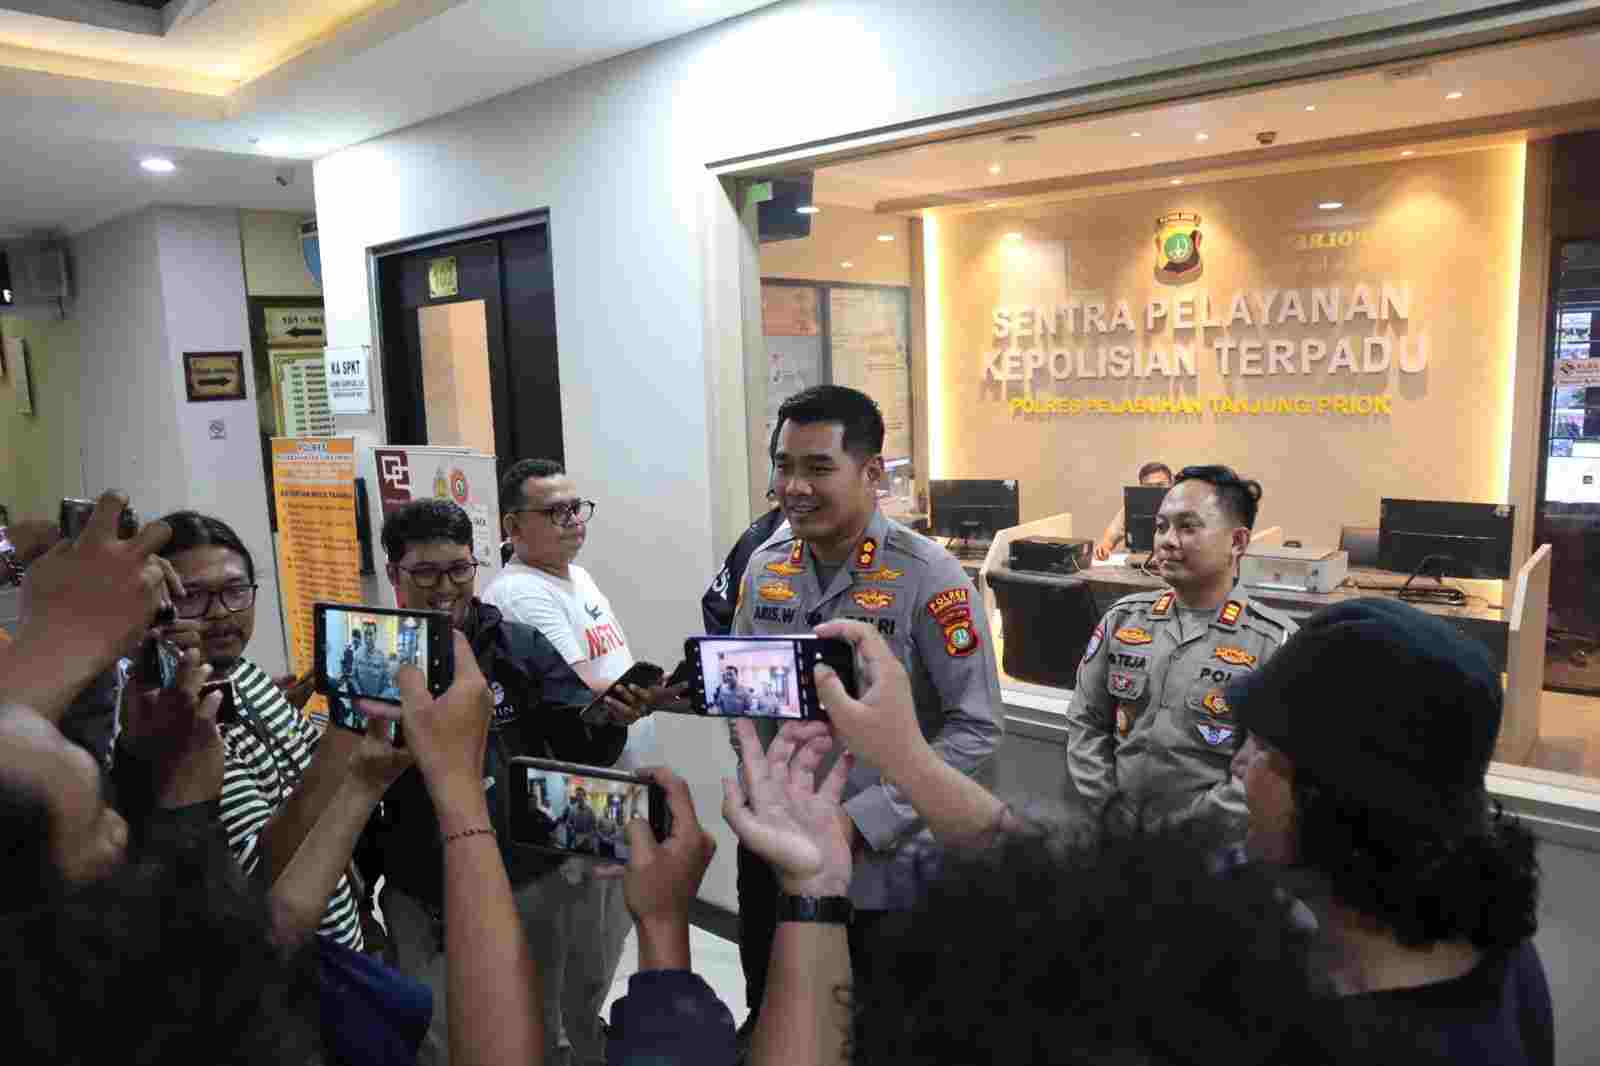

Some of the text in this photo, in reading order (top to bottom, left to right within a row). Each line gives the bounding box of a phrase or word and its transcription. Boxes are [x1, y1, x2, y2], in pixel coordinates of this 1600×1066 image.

[991, 283, 1410, 337] SENTRA PELAYANAN
[984, 334, 1427, 382] KEPOLISIAN TERPADU
[1008, 395, 1392, 416] POLRES PELABUHAN TANJUNG PRIOK
